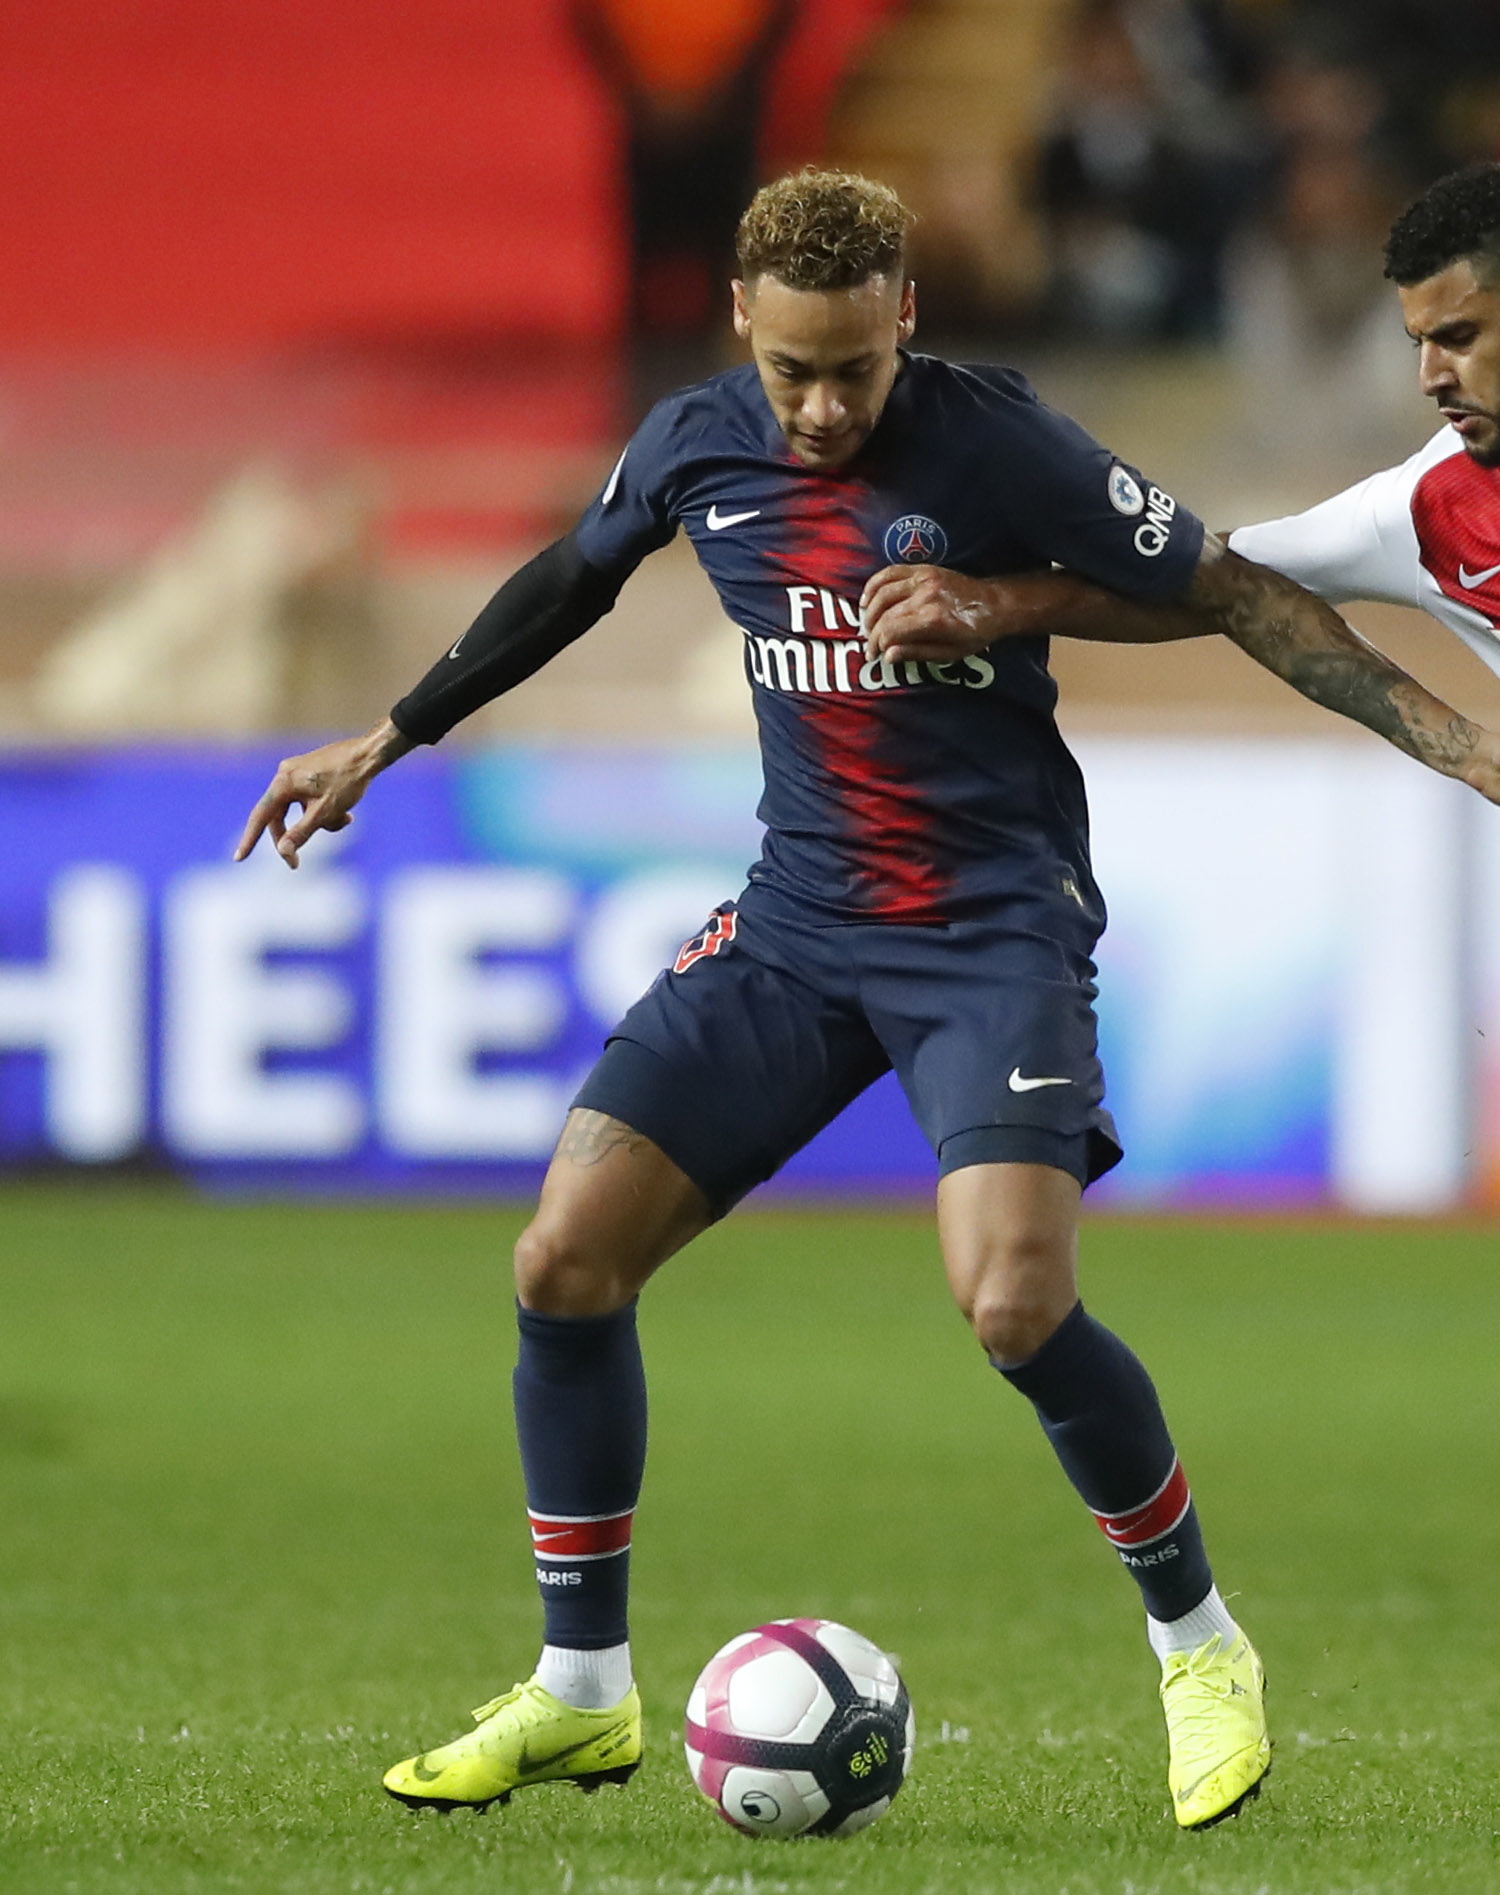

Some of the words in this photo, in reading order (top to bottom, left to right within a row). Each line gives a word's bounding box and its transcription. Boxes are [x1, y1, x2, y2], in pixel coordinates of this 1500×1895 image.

[896, 518, 936, 534] PARIS
[1134, 486, 1175, 556] QNB
[1119, 1544, 1180, 1568] PARIS
